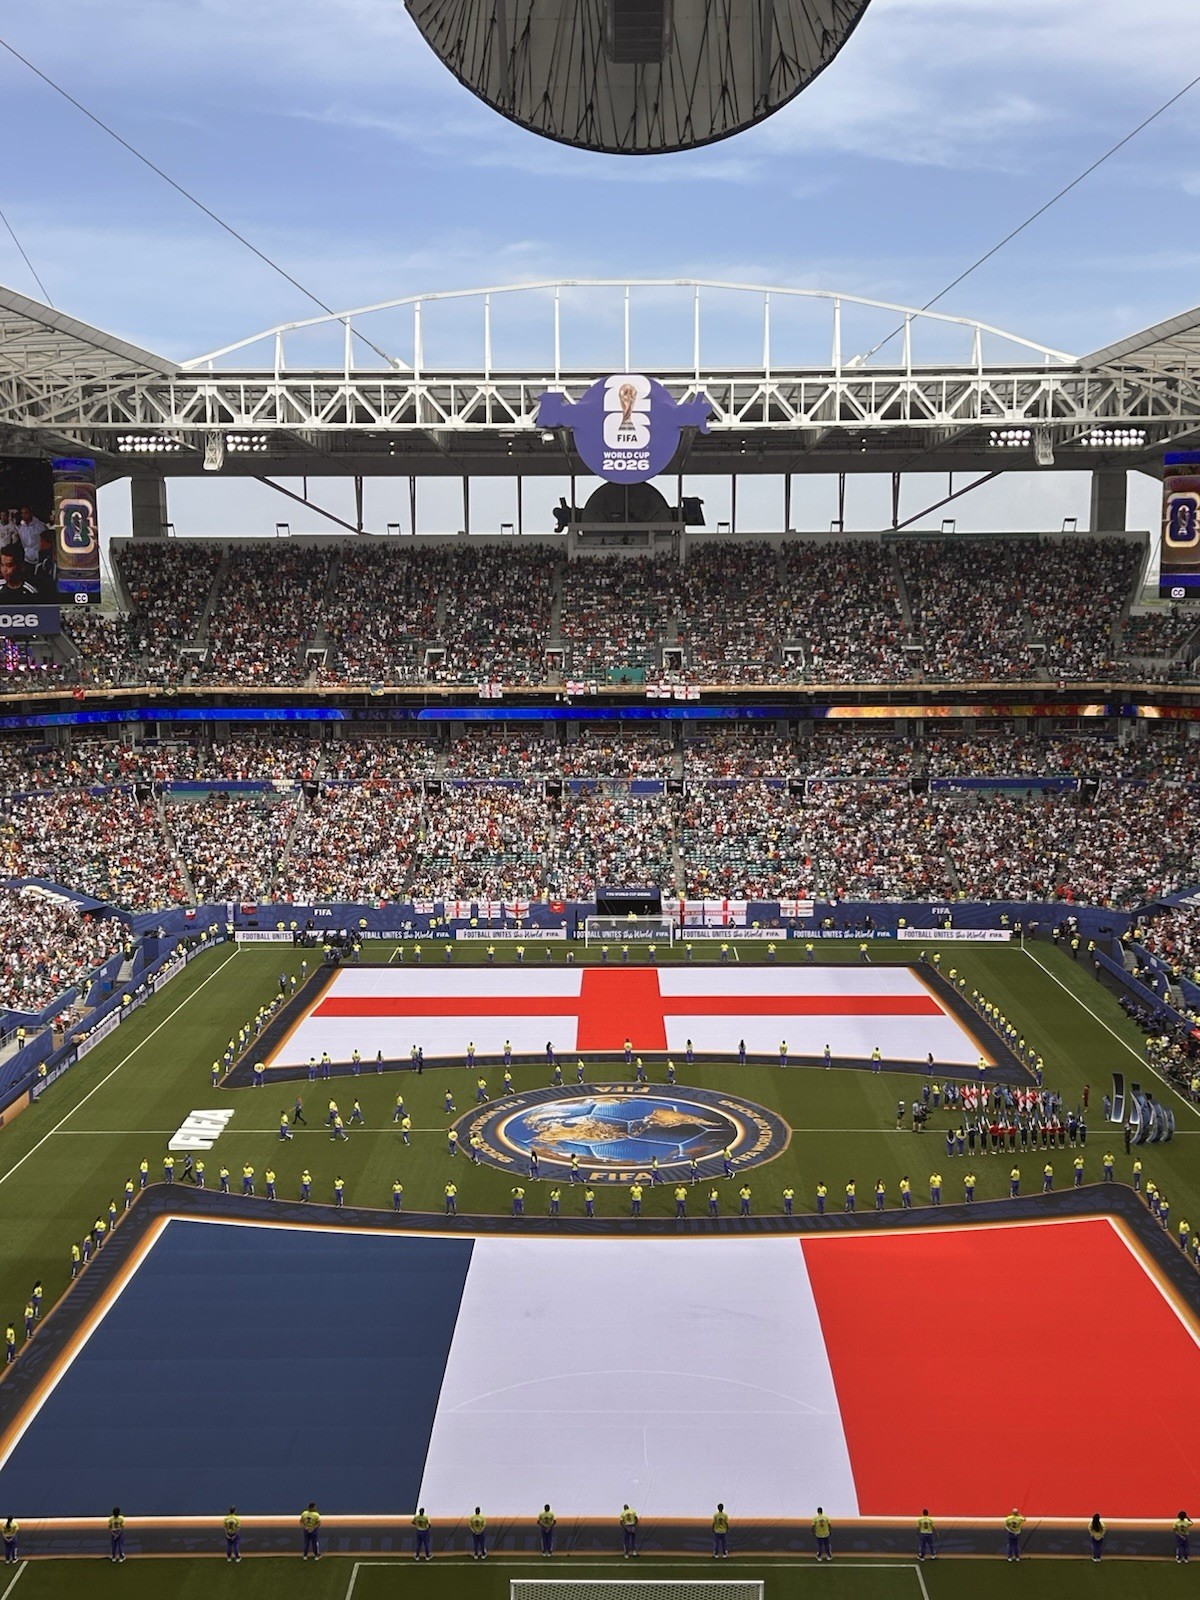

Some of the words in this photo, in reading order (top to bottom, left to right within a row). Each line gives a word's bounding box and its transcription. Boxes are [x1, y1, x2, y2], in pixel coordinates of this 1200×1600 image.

[617, 434, 637, 442] FIFA
[603, 460, 650, 470] 2026
[272, 932, 292, 940] UNITES
[464, 931, 491, 939] FOOTBALL
[683, 930, 710, 938] FOOTBALL
[793, 930, 821, 938] FOOTBALL
[168, 1109, 235, 1150] FIFA
[589, 1172, 652, 1180] FIFA
